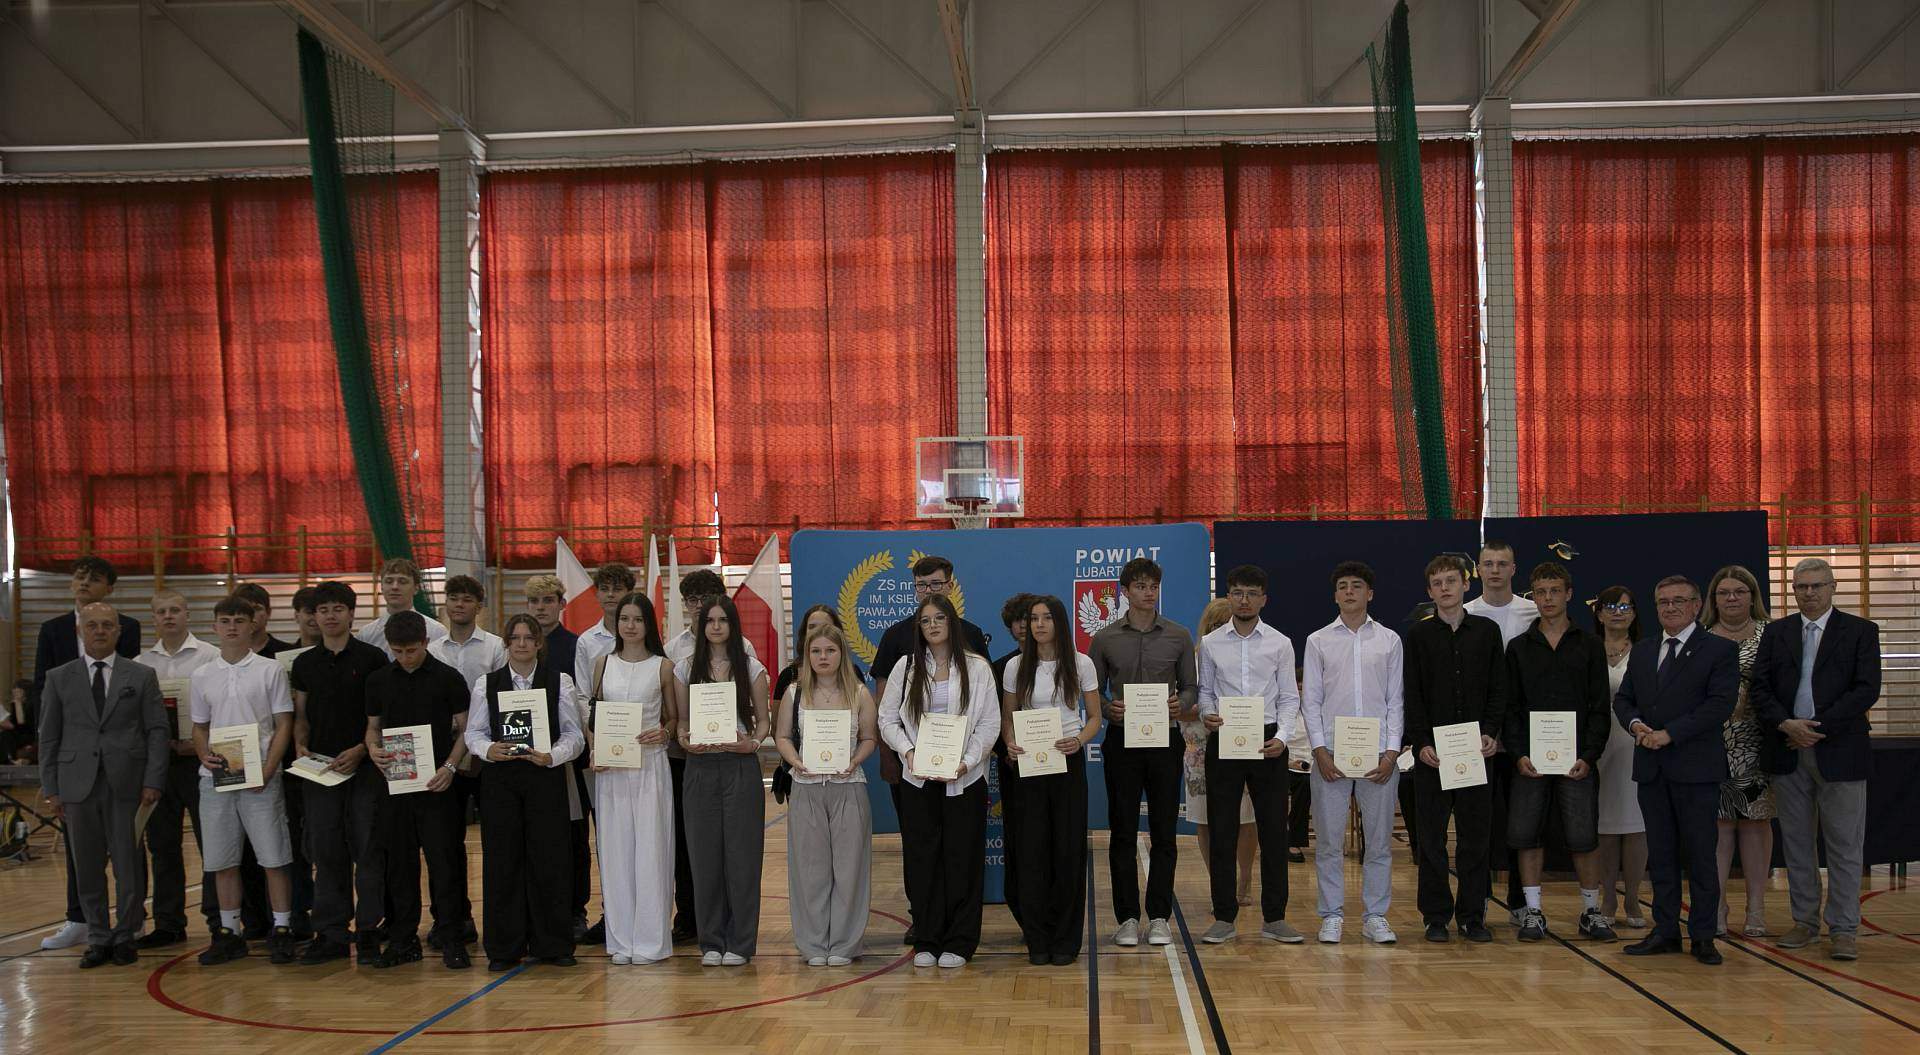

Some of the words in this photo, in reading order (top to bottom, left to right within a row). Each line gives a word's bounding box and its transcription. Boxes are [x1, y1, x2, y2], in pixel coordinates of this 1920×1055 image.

[1076, 547, 1161, 564] POWIAT
[1076, 566, 1122, 578] LUBART
[877, 579, 896, 591] ZS
[900, 581, 912, 591] nr
[869, 594, 885, 604] IM.
[858, 606, 896, 617] PAWŁA
[502, 725, 532, 738] Dary
